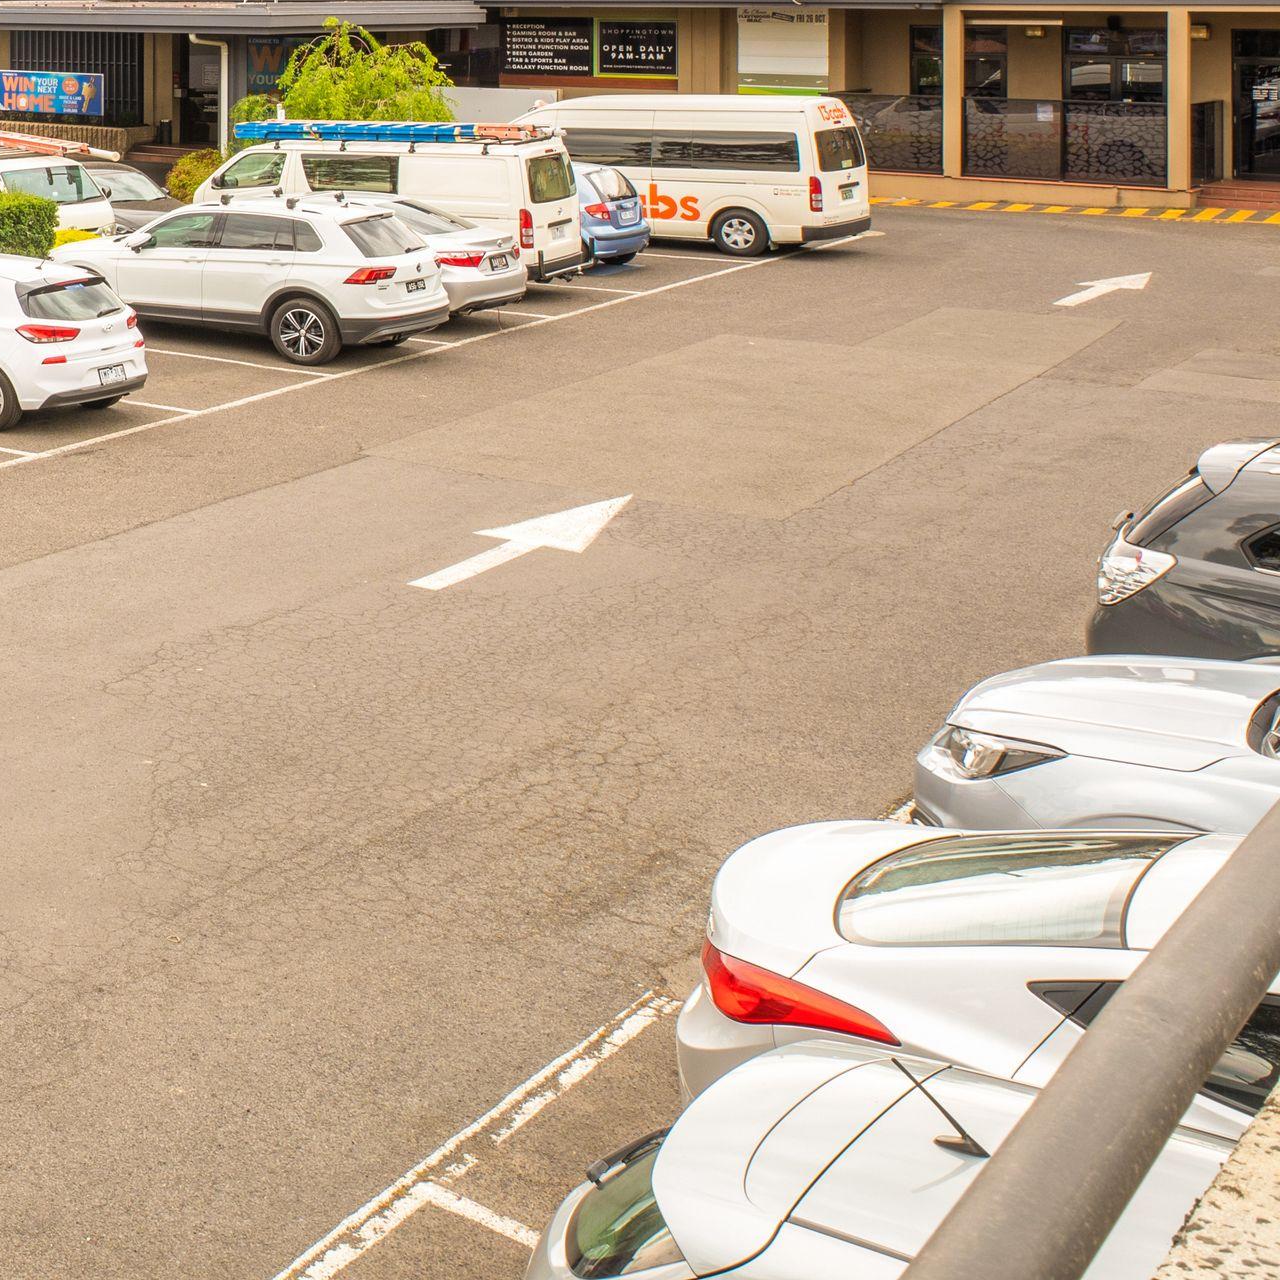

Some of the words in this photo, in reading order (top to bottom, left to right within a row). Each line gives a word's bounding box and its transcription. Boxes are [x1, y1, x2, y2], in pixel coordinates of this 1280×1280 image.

[806, 14, 813, 23] 26
[815, 15, 826, 23] OCT
[2, 76, 34, 92] WIN
[37, 78, 58, 86] YOUR
[4, 93, 55, 112] HOME
[818, 104, 847, 121] 13cabs
